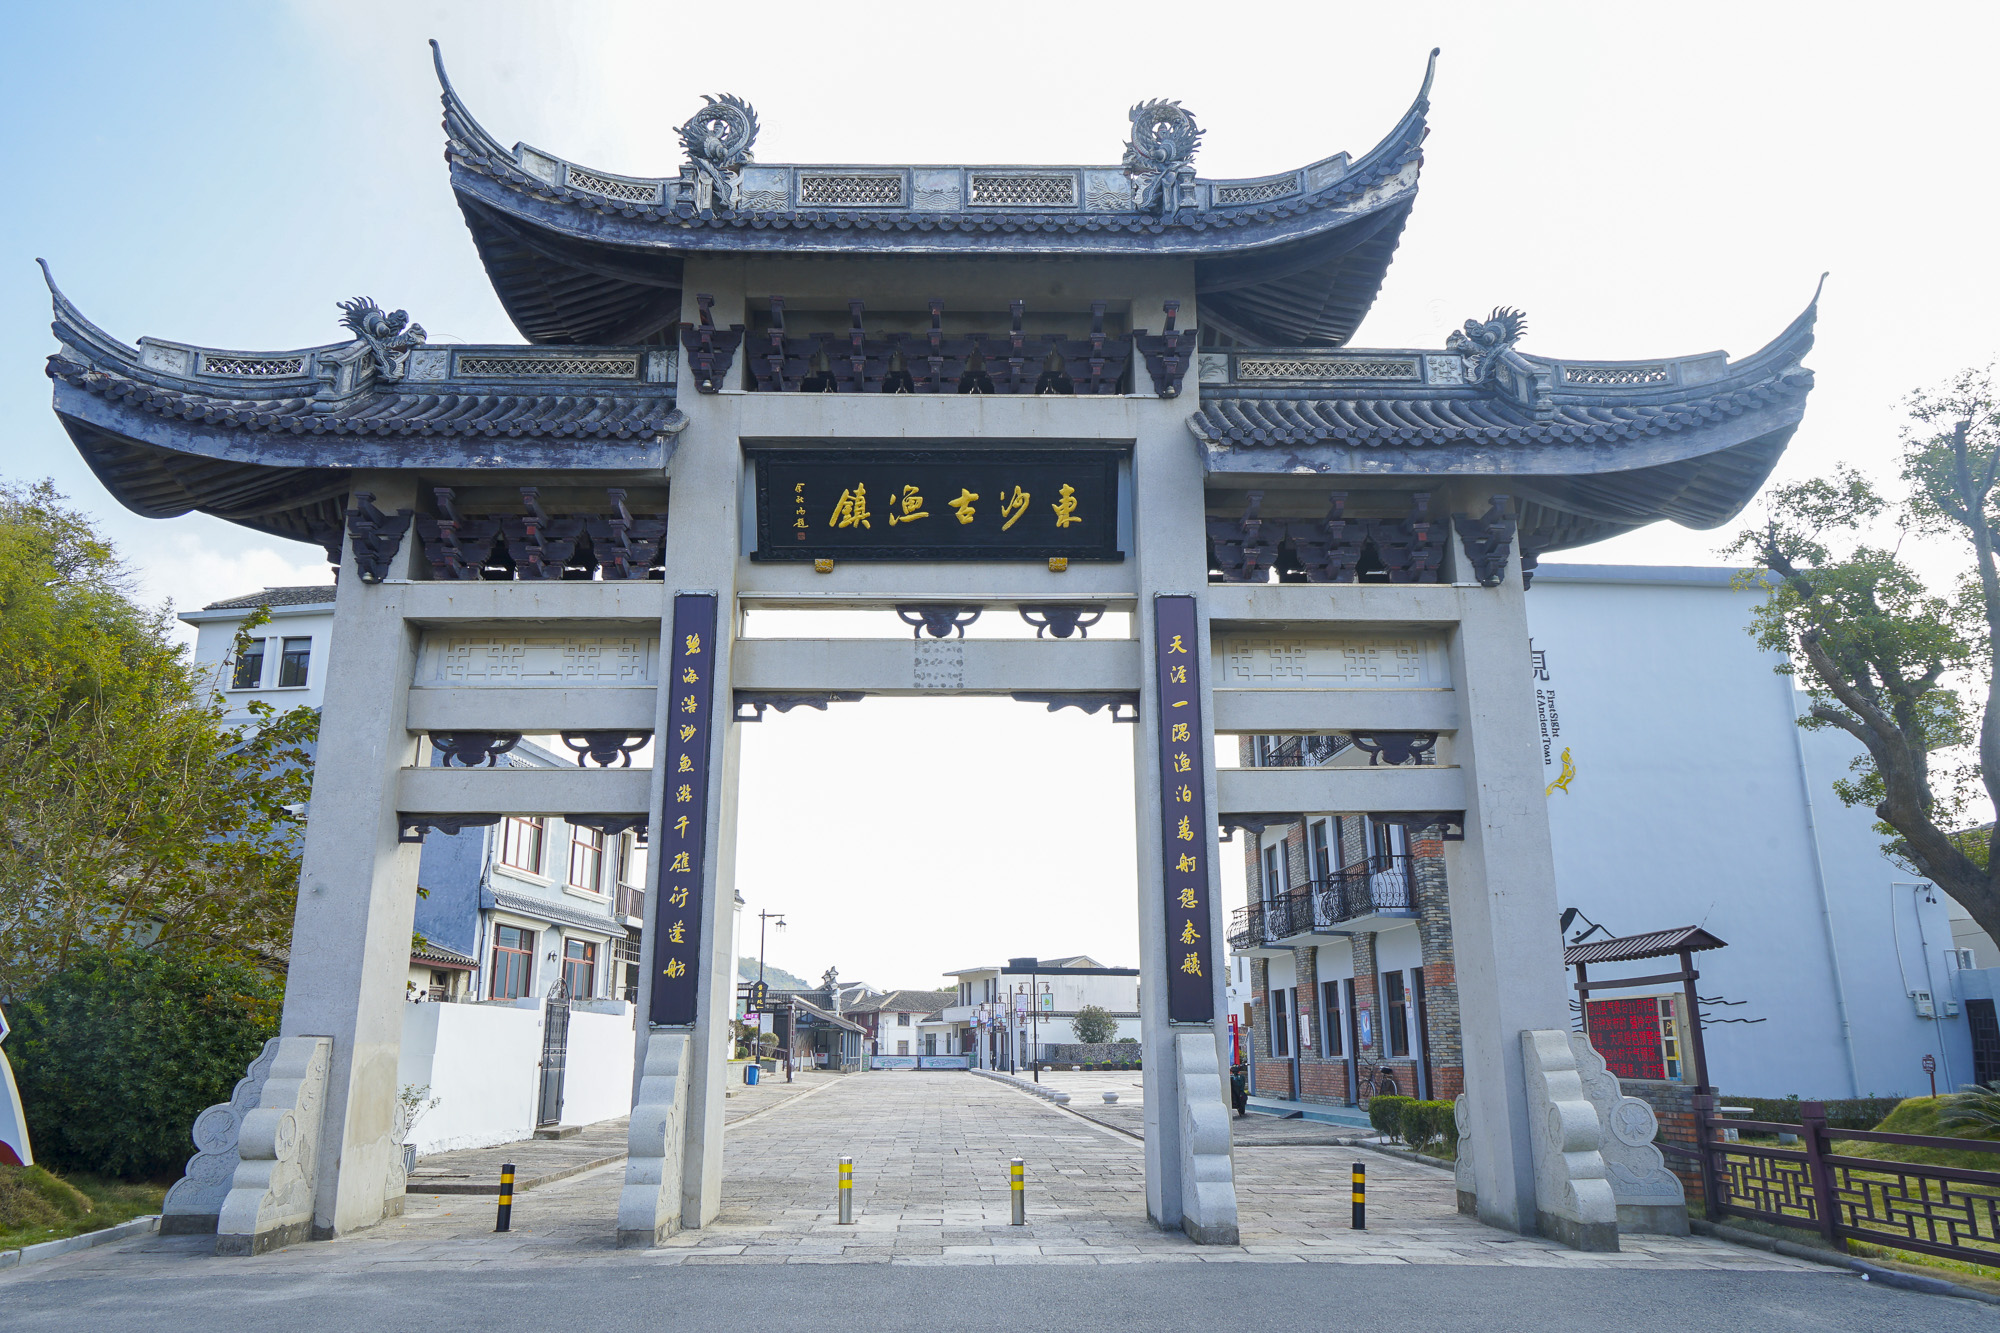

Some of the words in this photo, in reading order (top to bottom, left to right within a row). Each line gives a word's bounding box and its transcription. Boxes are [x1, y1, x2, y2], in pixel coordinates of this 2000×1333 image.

[1536, 689, 1546, 699] of
[1546, 690, 1556, 712] First
[1538, 700, 1549, 737] Ancient
[1550, 713, 1560, 737] Sight
[1543, 738, 1551, 765] Town
